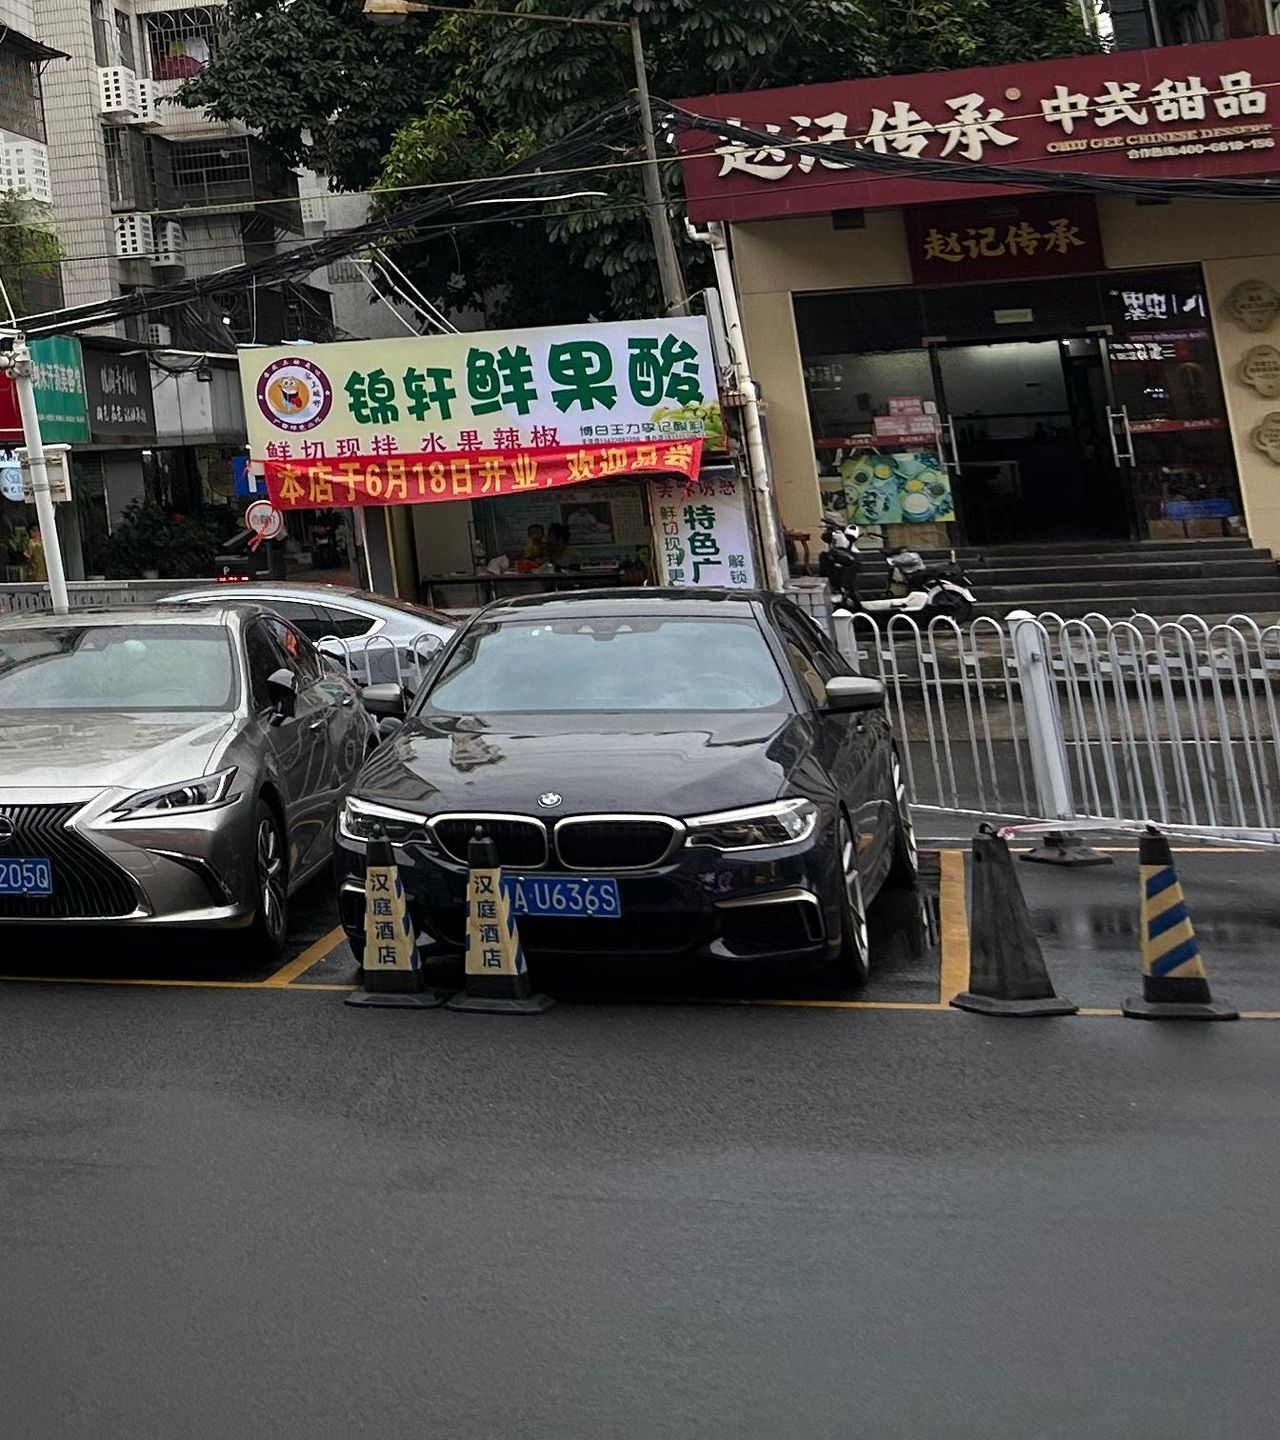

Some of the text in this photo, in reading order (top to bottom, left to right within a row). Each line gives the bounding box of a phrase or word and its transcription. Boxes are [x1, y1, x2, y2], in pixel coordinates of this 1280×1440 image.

[1041, 70, 1266, 134] 中式甜品
[714, 93, 1018, 180] 赵记传承
[1047, 140, 1087, 152] CHIU
[1091, 136, 1124, 149] GEE
[1126, 130, 1197, 146] CHINESE
[924, 218, 1086, 262] 赵记传承
[266, 425, 560, 461] 鲜切现拌 水果辣椒
[370, 873, 397, 965] 汉庭酒店
[474, 875, 502, 969] 汉庭酒店
